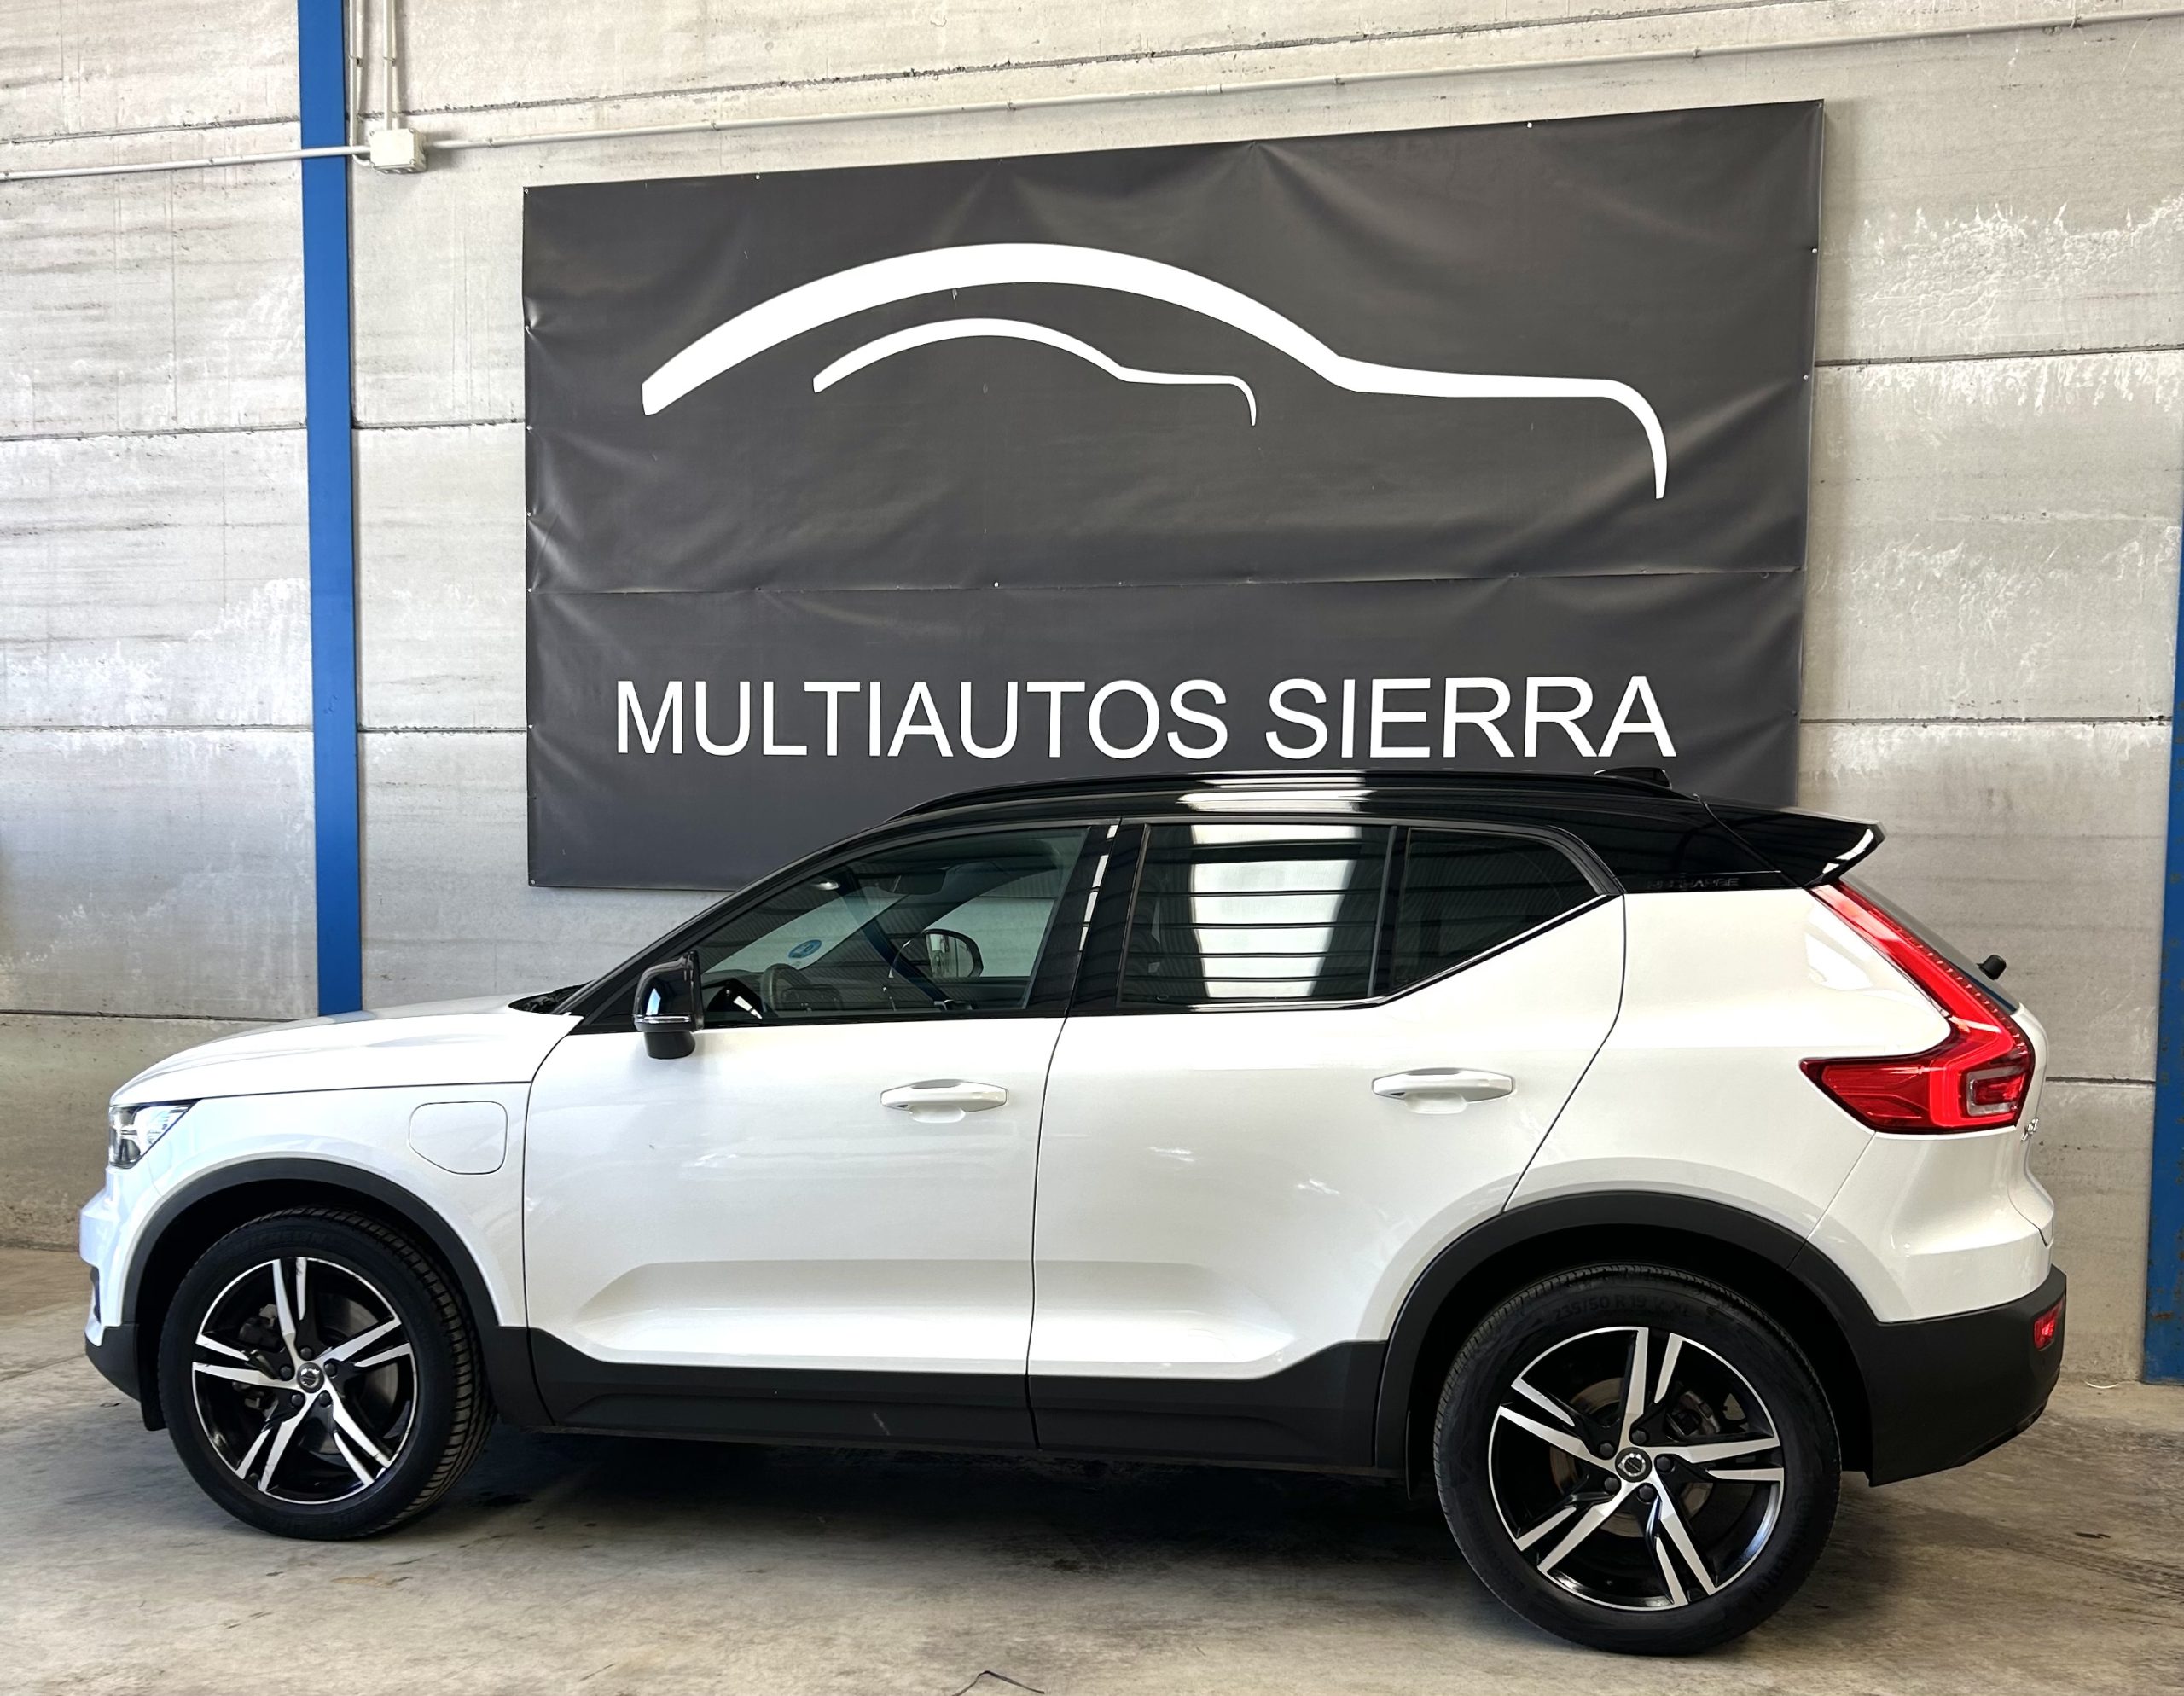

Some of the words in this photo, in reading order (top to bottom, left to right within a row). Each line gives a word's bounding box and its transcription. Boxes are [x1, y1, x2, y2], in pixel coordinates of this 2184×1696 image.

[617, 679, 1228, 759] MULTIAUTOS
[1265, 675, 1677, 759] SIERRA
[1554, 1295, 1611, 1321] 235/50
